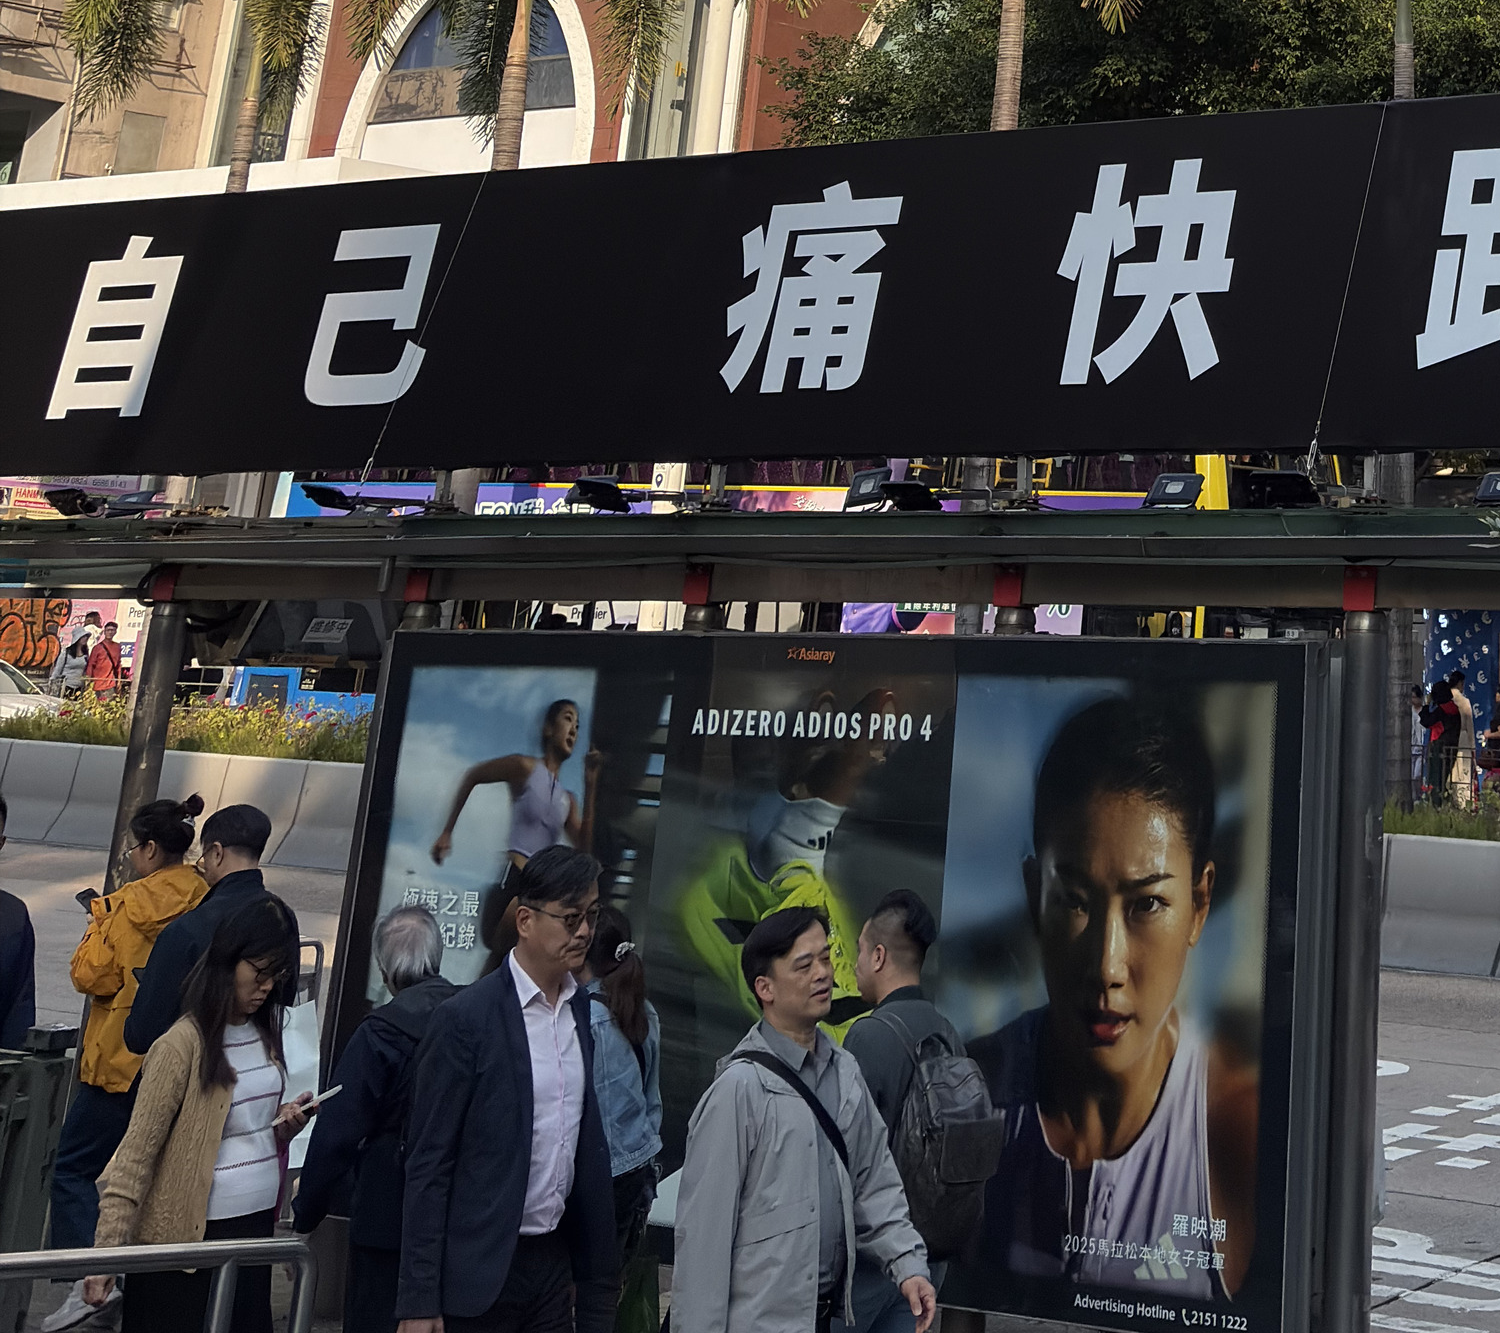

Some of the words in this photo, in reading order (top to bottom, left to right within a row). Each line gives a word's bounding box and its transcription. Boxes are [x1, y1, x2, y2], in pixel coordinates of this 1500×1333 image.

[571, 606, 608, 620] Prier
[798, 647, 835, 665] Asiaray
[691, 708, 787, 738] ADIZERO
[792, 711, 862, 740] ADIOS
[868, 713, 913, 742] PRO
[920, 714, 932, 743] 4
[402, 887, 480, 918] 極速之最
[1172, 1213, 1227, 1243] 羅映潮
[1064, 1234, 1225, 1271] 2025馬拉松本地女子冠軍
[1074, 1293, 1134, 1318] Advertising
[1136, 1302, 1176, 1322] Hotline
[1191, 1310, 1218, 1328] 2151
[1221, 1314, 1248, 1331] 1222
